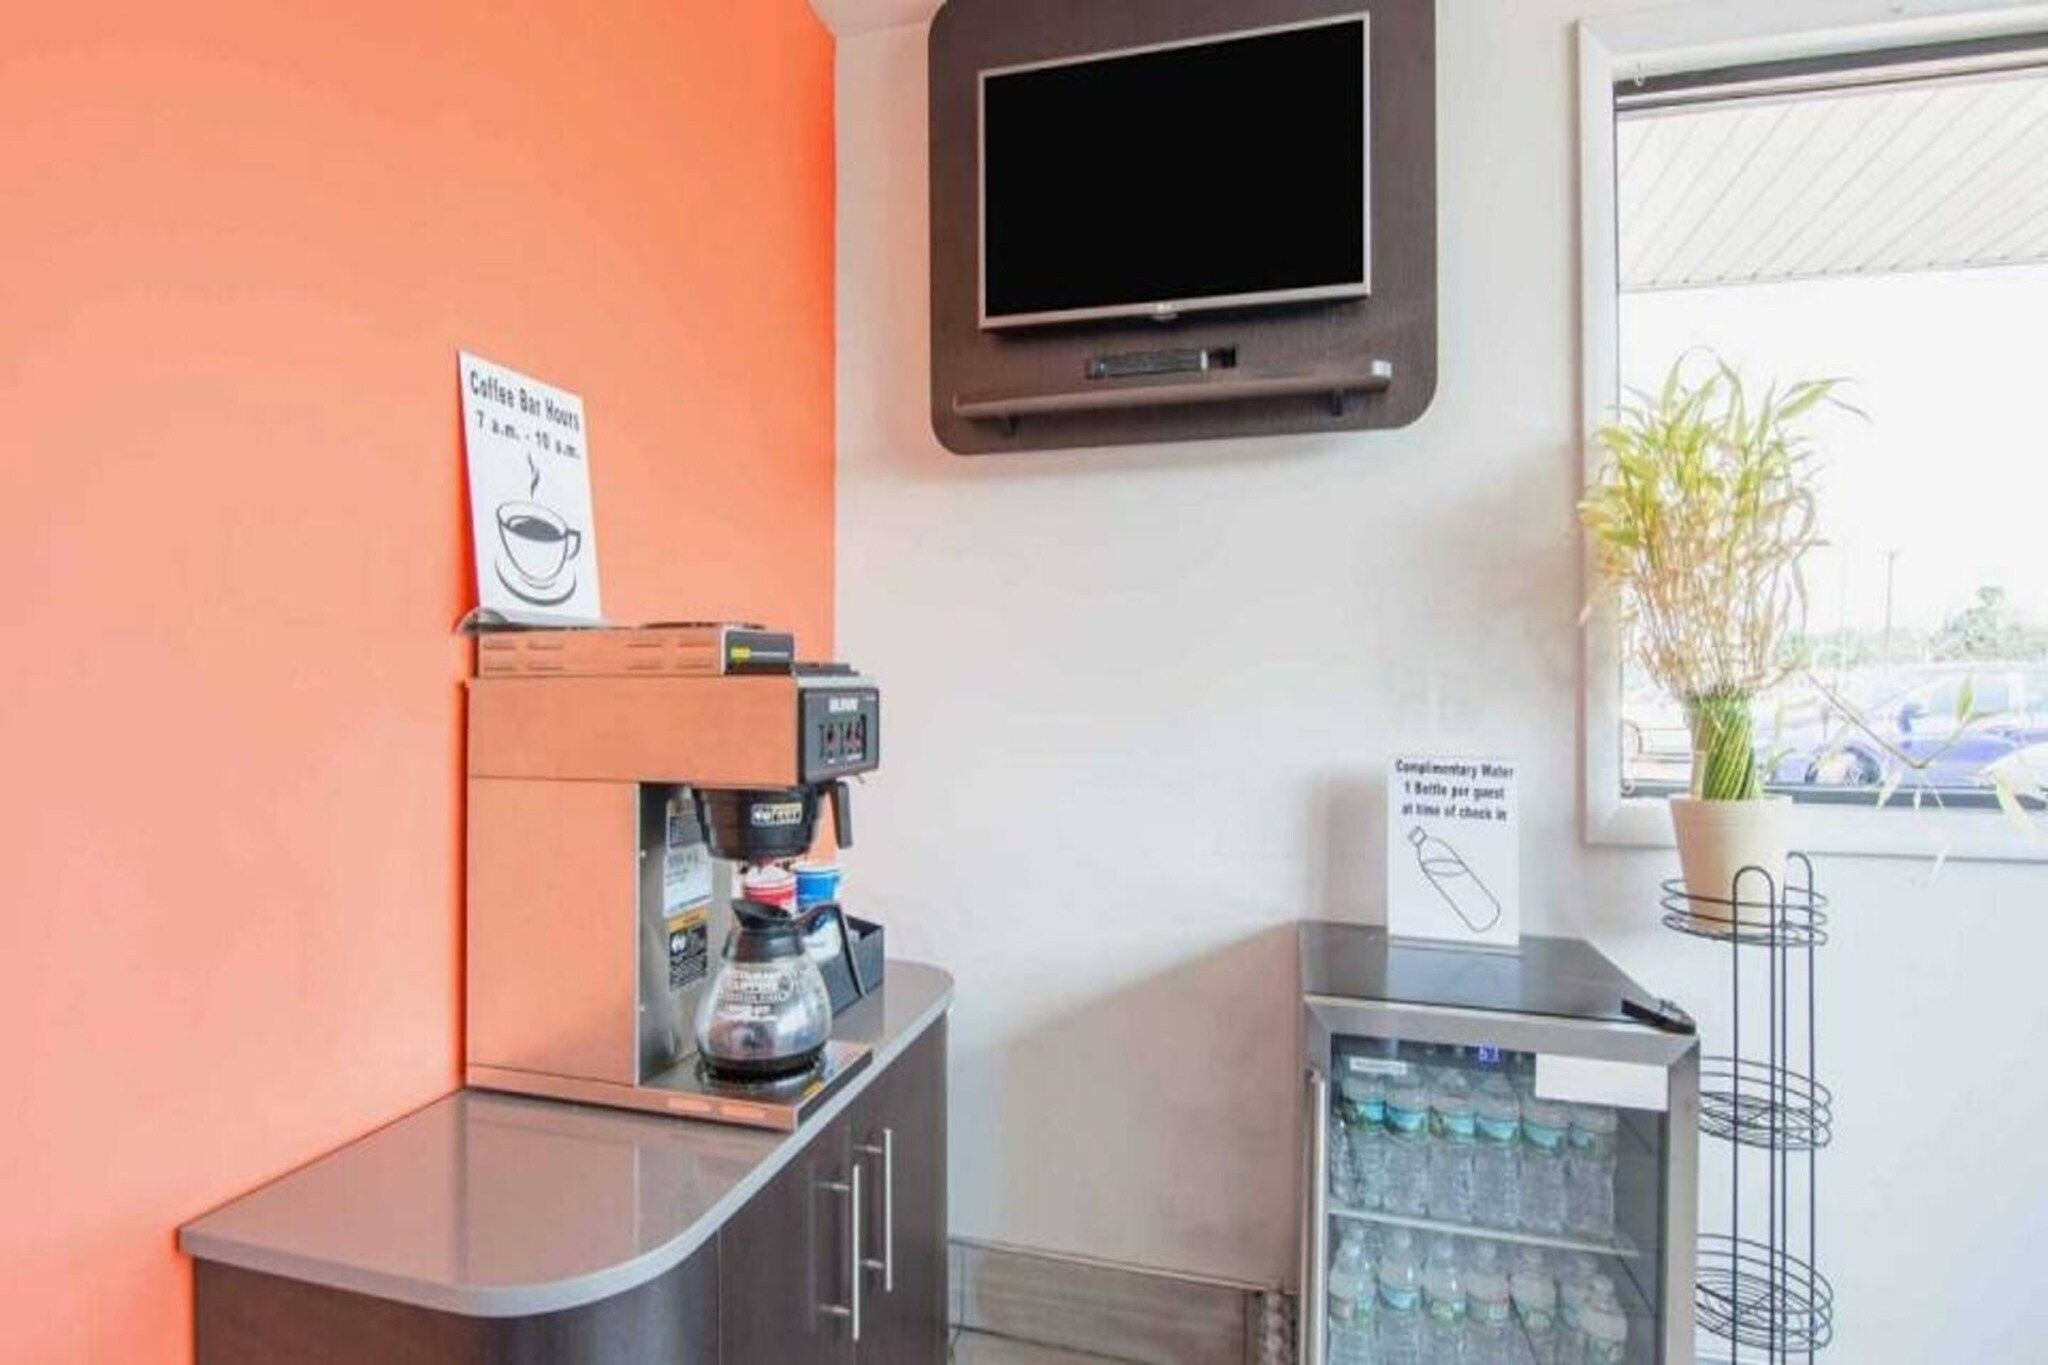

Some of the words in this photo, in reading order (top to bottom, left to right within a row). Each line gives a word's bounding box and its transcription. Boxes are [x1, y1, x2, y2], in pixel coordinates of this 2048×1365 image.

[470, 370, 514, 408] Coffee
[519, 387, 541, 416] Bar
[545, 397, 580, 432] Hours
[477, 409, 485, 429] 7
[492, 419, 520, 440] a.m.
[536, 430, 550, 450] 10
[556, 441, 581, 459] a.m.
[1395, 759, 1478, 780] Complimentary
[1481, 763, 1514, 777] Water
[1404, 781, 1411, 794] 1
[1414, 782, 1447, 796] Bottle
[1452, 786, 1469, 799] per
[1473, 788, 1504, 801] guest
[1402, 804, 1413, 815] at
[1416, 804, 1440, 816] time
[1444, 804, 1456, 817] of
[1459, 806, 1492, 819] check
[1496, 808, 1507, 821] in
